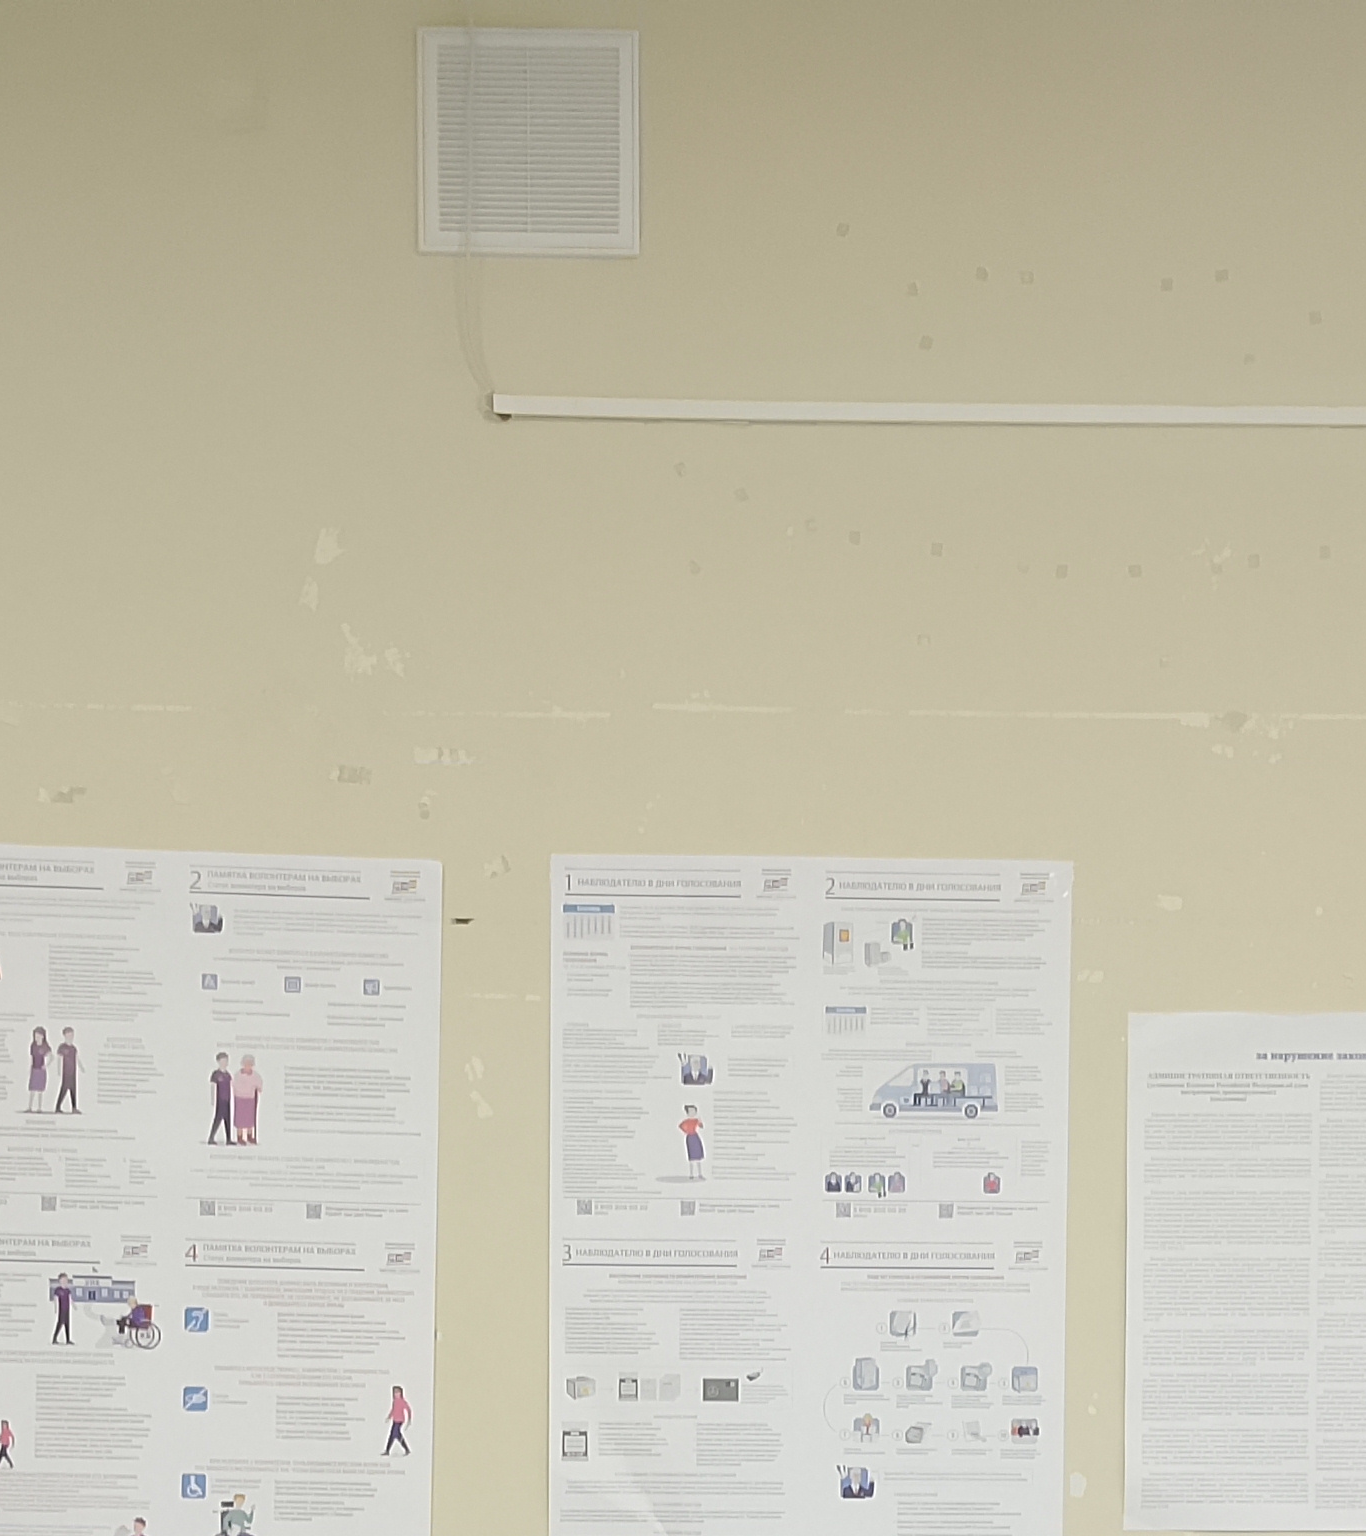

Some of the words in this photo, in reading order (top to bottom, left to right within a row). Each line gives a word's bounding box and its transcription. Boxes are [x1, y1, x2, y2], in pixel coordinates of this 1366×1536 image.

[190, 871, 201, 889] 2
[565, 874, 571, 890] 1
[648, 879, 653, 887] В
[825, 877, 835, 895] 2
[1271, 1052, 1334, 1062] нарушение
[185, 1244, 197, 1262] 4
[562, 1244, 571, 1261] 3
[646, 1249, 650, 1257] В
[820, 1246, 829, 1264] 4
